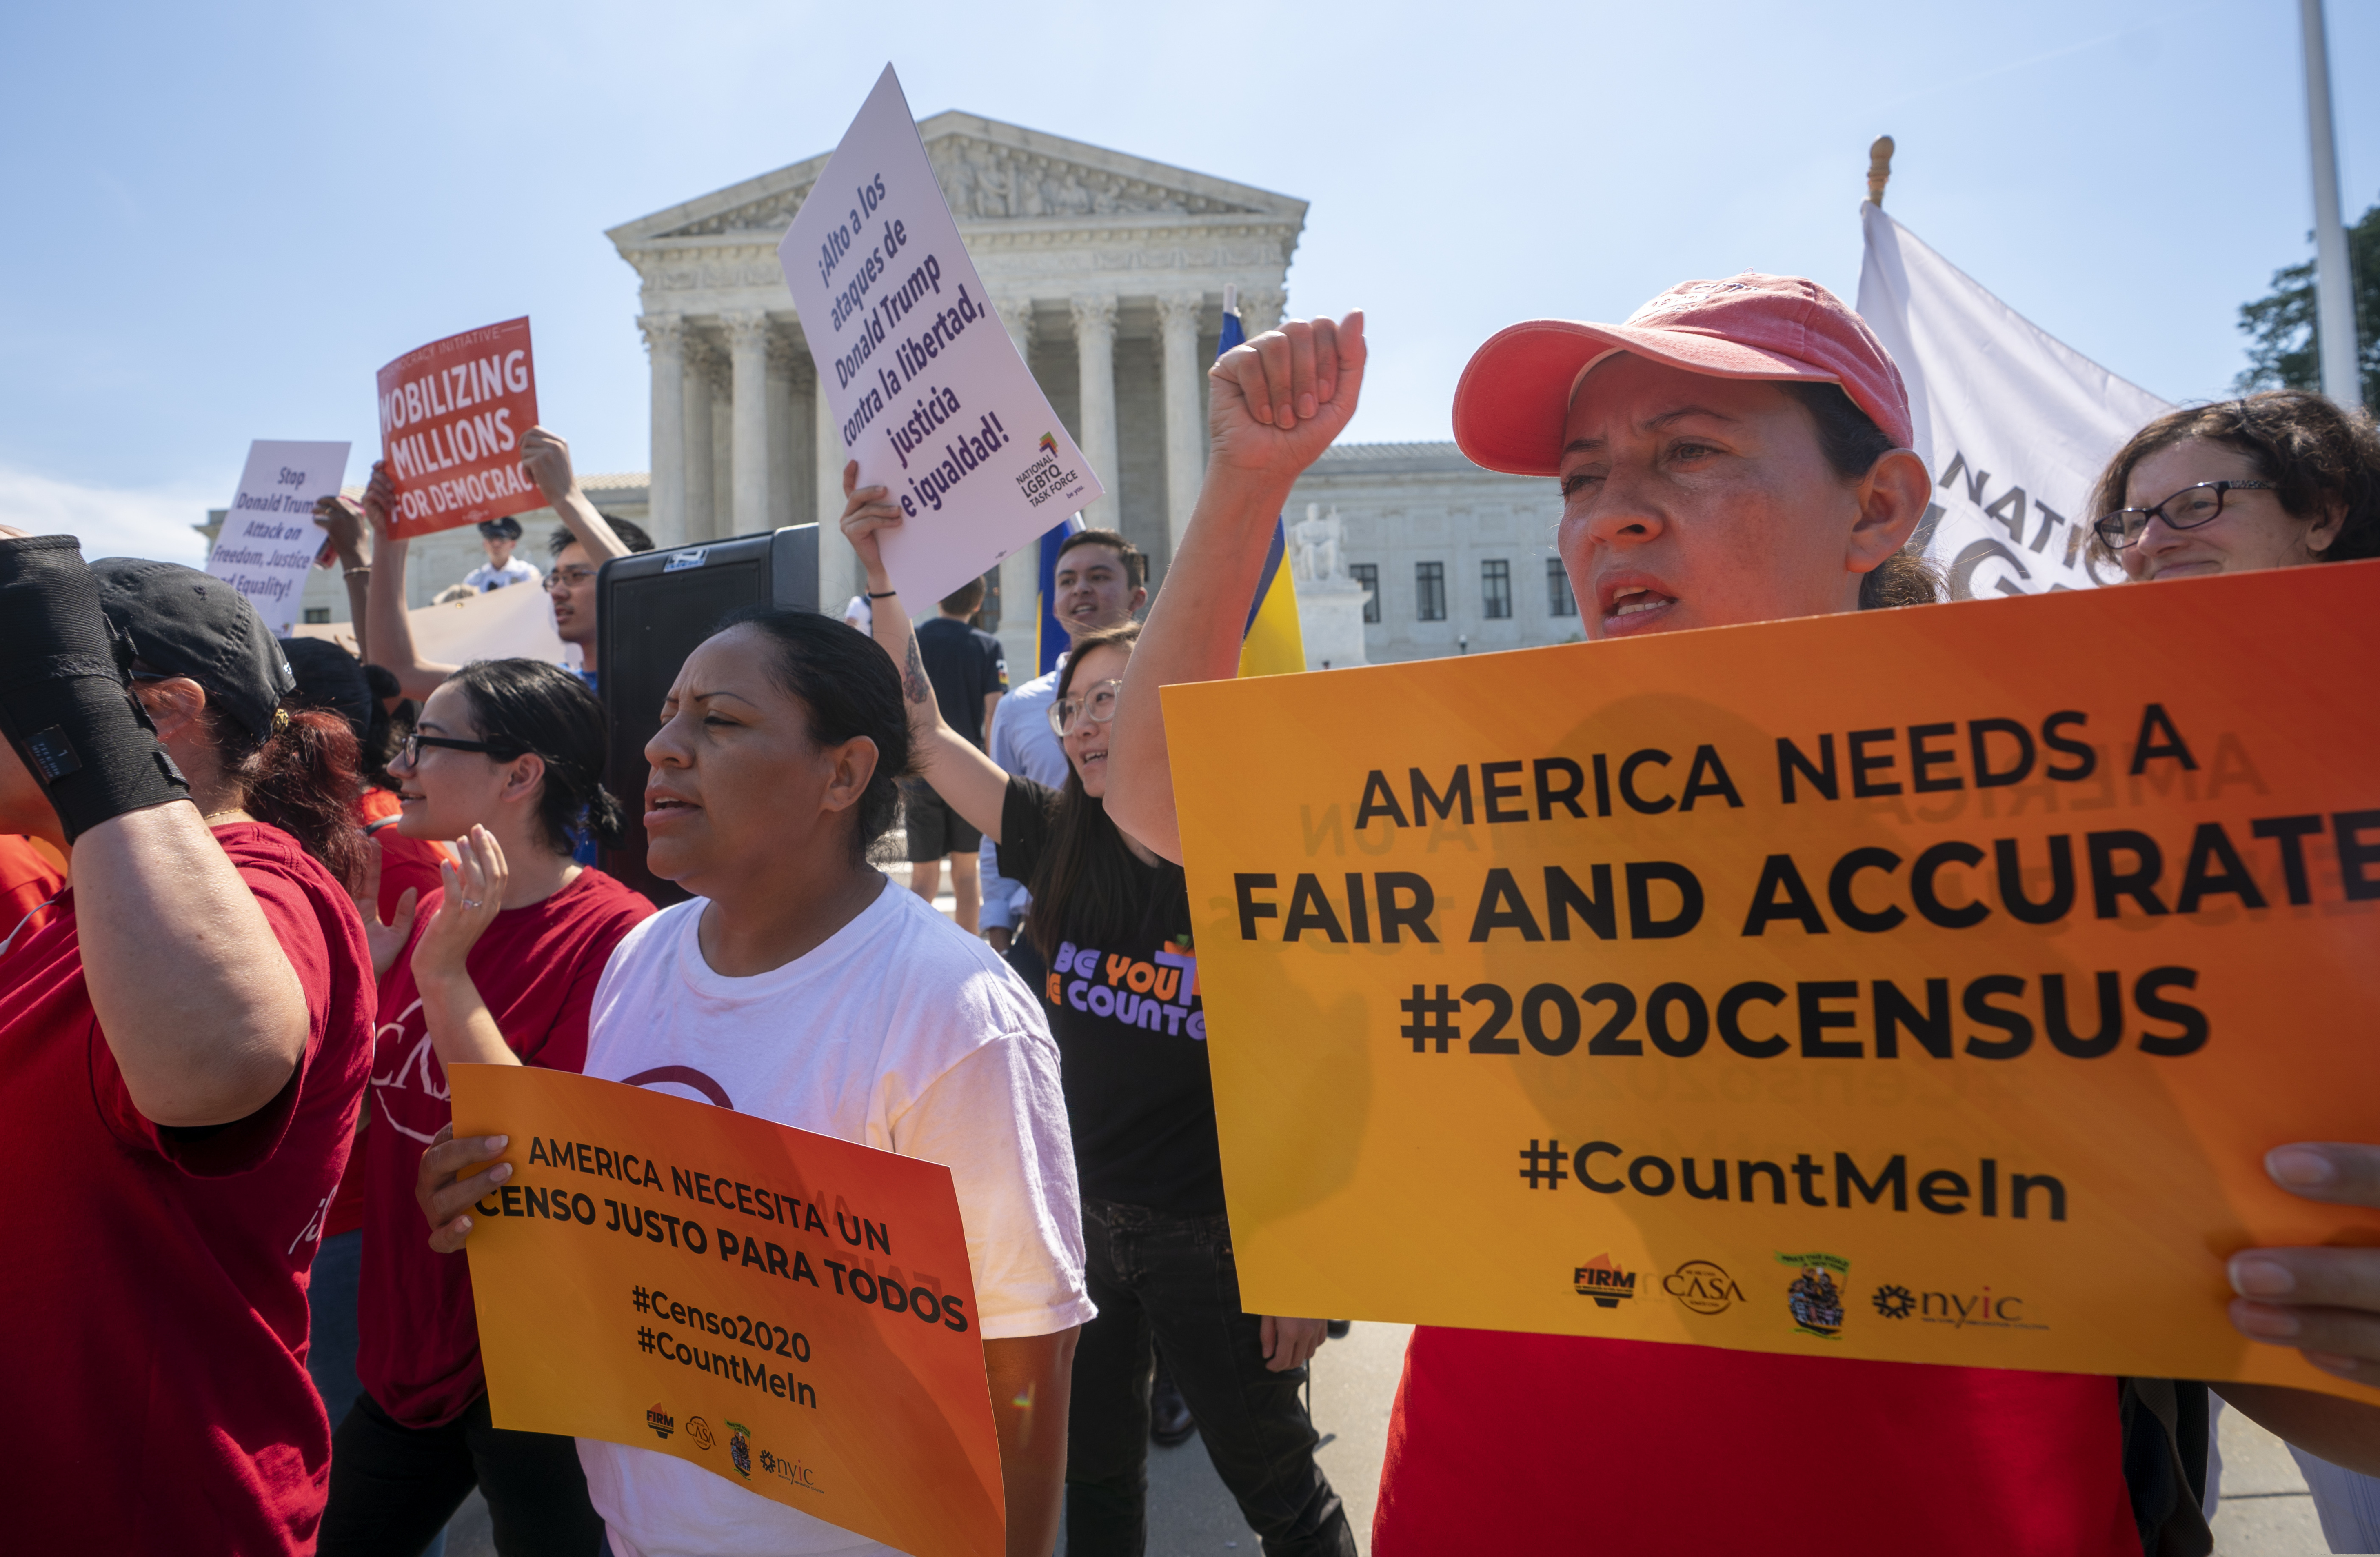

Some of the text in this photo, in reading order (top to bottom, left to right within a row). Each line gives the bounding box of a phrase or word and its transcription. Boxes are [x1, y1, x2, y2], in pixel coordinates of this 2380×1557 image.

[818, 173, 886, 289] ¡Alto a los
[831, 219, 907, 332] ataques de
[835, 254, 941, 390] Donald Trump
[843, 283, 986, 447] contra la libertad,
[390, 408, 515, 481] MILLIONS
[886, 386, 961, 469] justicia
[901, 411, 1010, 518] e igualdad!
[237, 493, 315, 513] Donald Trum
[278, 466, 305, 489] Stop
[428, 460, 540, 513] DEMOCRAC
[1016, 455, 1053, 485] NATIONAL
[1021, 464, 1062, 498] LGBTQ
[1029, 470, 1078, 508] TASK FORCE
[212, 544, 310, 569] Freedom, Justice
[243, 520, 302, 540] Attack on
[236, 574, 293, 602] Equality!
[1354, 744, 1745, 830] AMERICA
[1776, 709, 2096, 804] NEEDS
[2129, 703, 2199, 775] A
[1234, 871, 1441, 944] FAIR
[1468, 861, 1705, 942] AND
[1741, 809, 2380, 937] ACCURATE
[1053, 940, 1180, 1001] BE YOU
[1068, 980, 1207, 1041] COUNTE
[1400, 966, 2211, 1060] #2020CENSUS
[528, 1136, 892, 1257] AMERICA NECESITA UN
[1519, 1139, 2067, 1222] #CountMeIn
[605, 1198, 708, 1255] JUSTO
[717, 1228, 819, 1288] PARA
[823, 1258, 969, 1333] TODOS
[1574, 1267, 2023, 1329] FIRM CASA nyic
[631, 1284, 811, 1363] #Censo2020
[637, 1325, 817, 1409] #CountMeIn
[647, 1410, 674, 1428] FIRM
[686, 1422, 717, 1446] CASA
[777, 1458, 814, 1485] nyic
